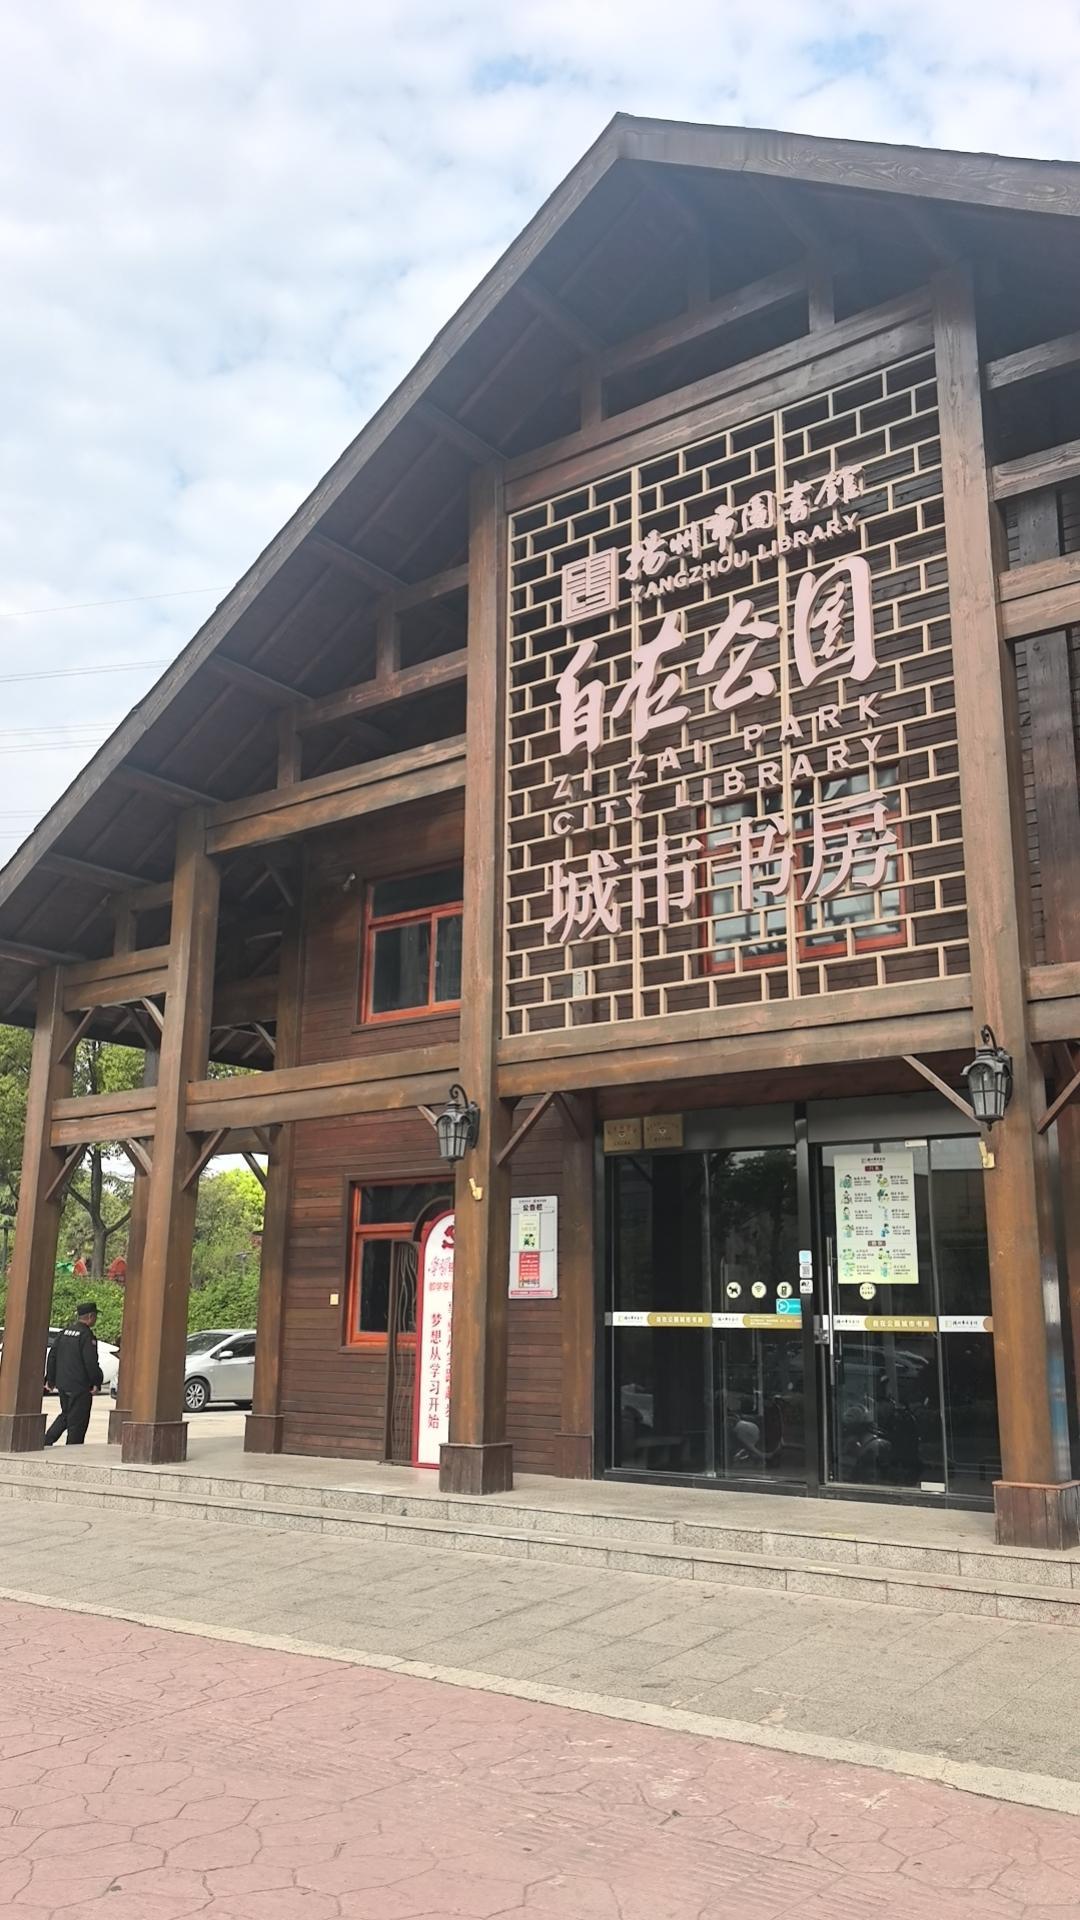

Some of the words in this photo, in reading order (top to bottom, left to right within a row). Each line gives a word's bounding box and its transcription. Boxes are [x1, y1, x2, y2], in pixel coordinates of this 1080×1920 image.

[631, 549, 750, 604] YANGZHOU
[758, 511, 861, 561] LIBRARY
[552, 769, 592, 800] ZI
[628, 740, 704, 781] ZAI
[744, 692, 882, 751] PARK
[553, 793, 645, 836] CITY
[676, 735, 883, 808] LIBRARY
[545, 791, 899, 944] 城市书房
[427, 1313, 442, 1429] 梦想从学习开始
